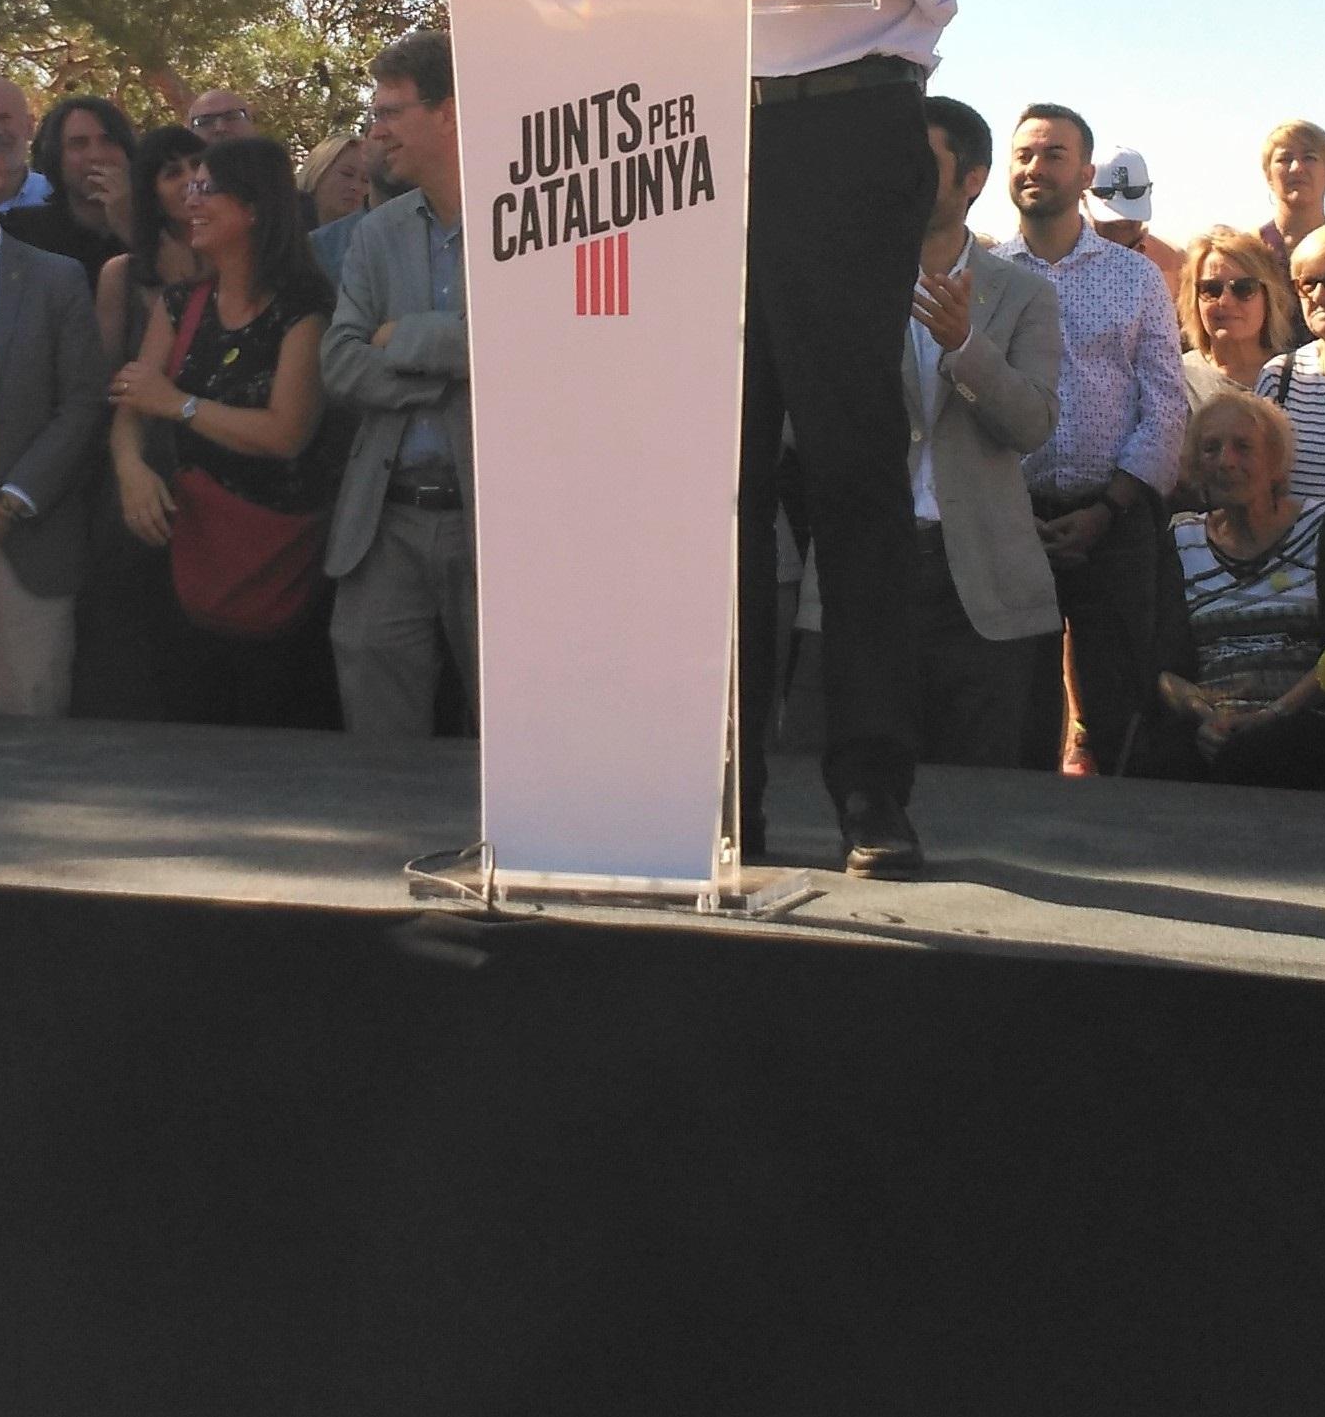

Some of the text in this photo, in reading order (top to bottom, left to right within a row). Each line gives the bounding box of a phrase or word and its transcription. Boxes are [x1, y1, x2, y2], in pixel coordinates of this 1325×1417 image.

[509, 82, 695, 185] JUNTS PER
[492, 135, 716, 262] CATALUNYA
